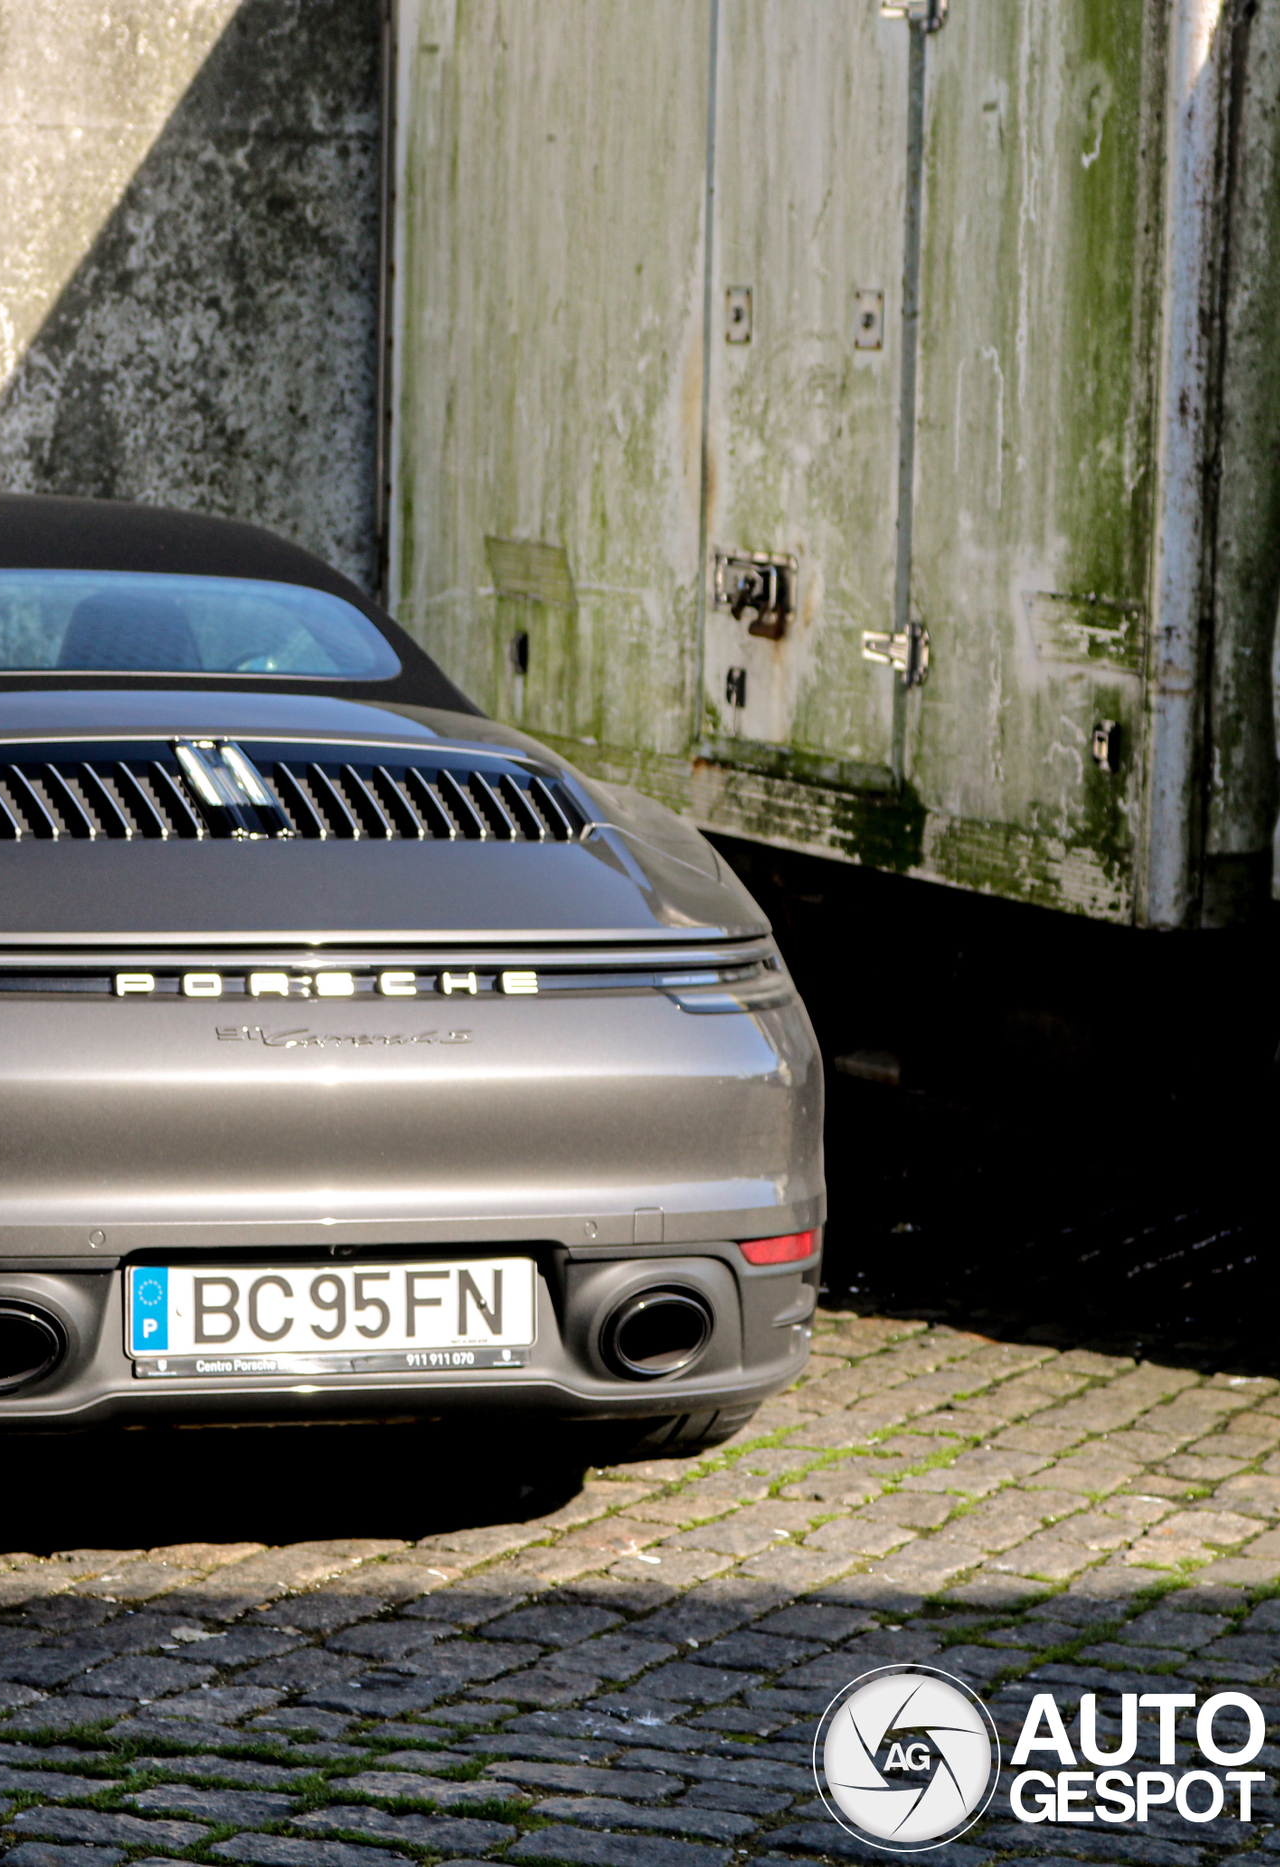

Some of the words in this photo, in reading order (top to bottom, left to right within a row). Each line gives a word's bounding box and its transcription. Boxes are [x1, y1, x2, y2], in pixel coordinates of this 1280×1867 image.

[116, 971, 539, 997] PORSCHE
[142, 1318, 159, 1340] P
[196, 1359, 233, 1373] Centro
[233, 1358, 277, 1372] Porsche
[406, 1353, 428, 1367] 911
[429, 1352, 451, 1366] 911
[452, 1352, 475, 1365] 070
